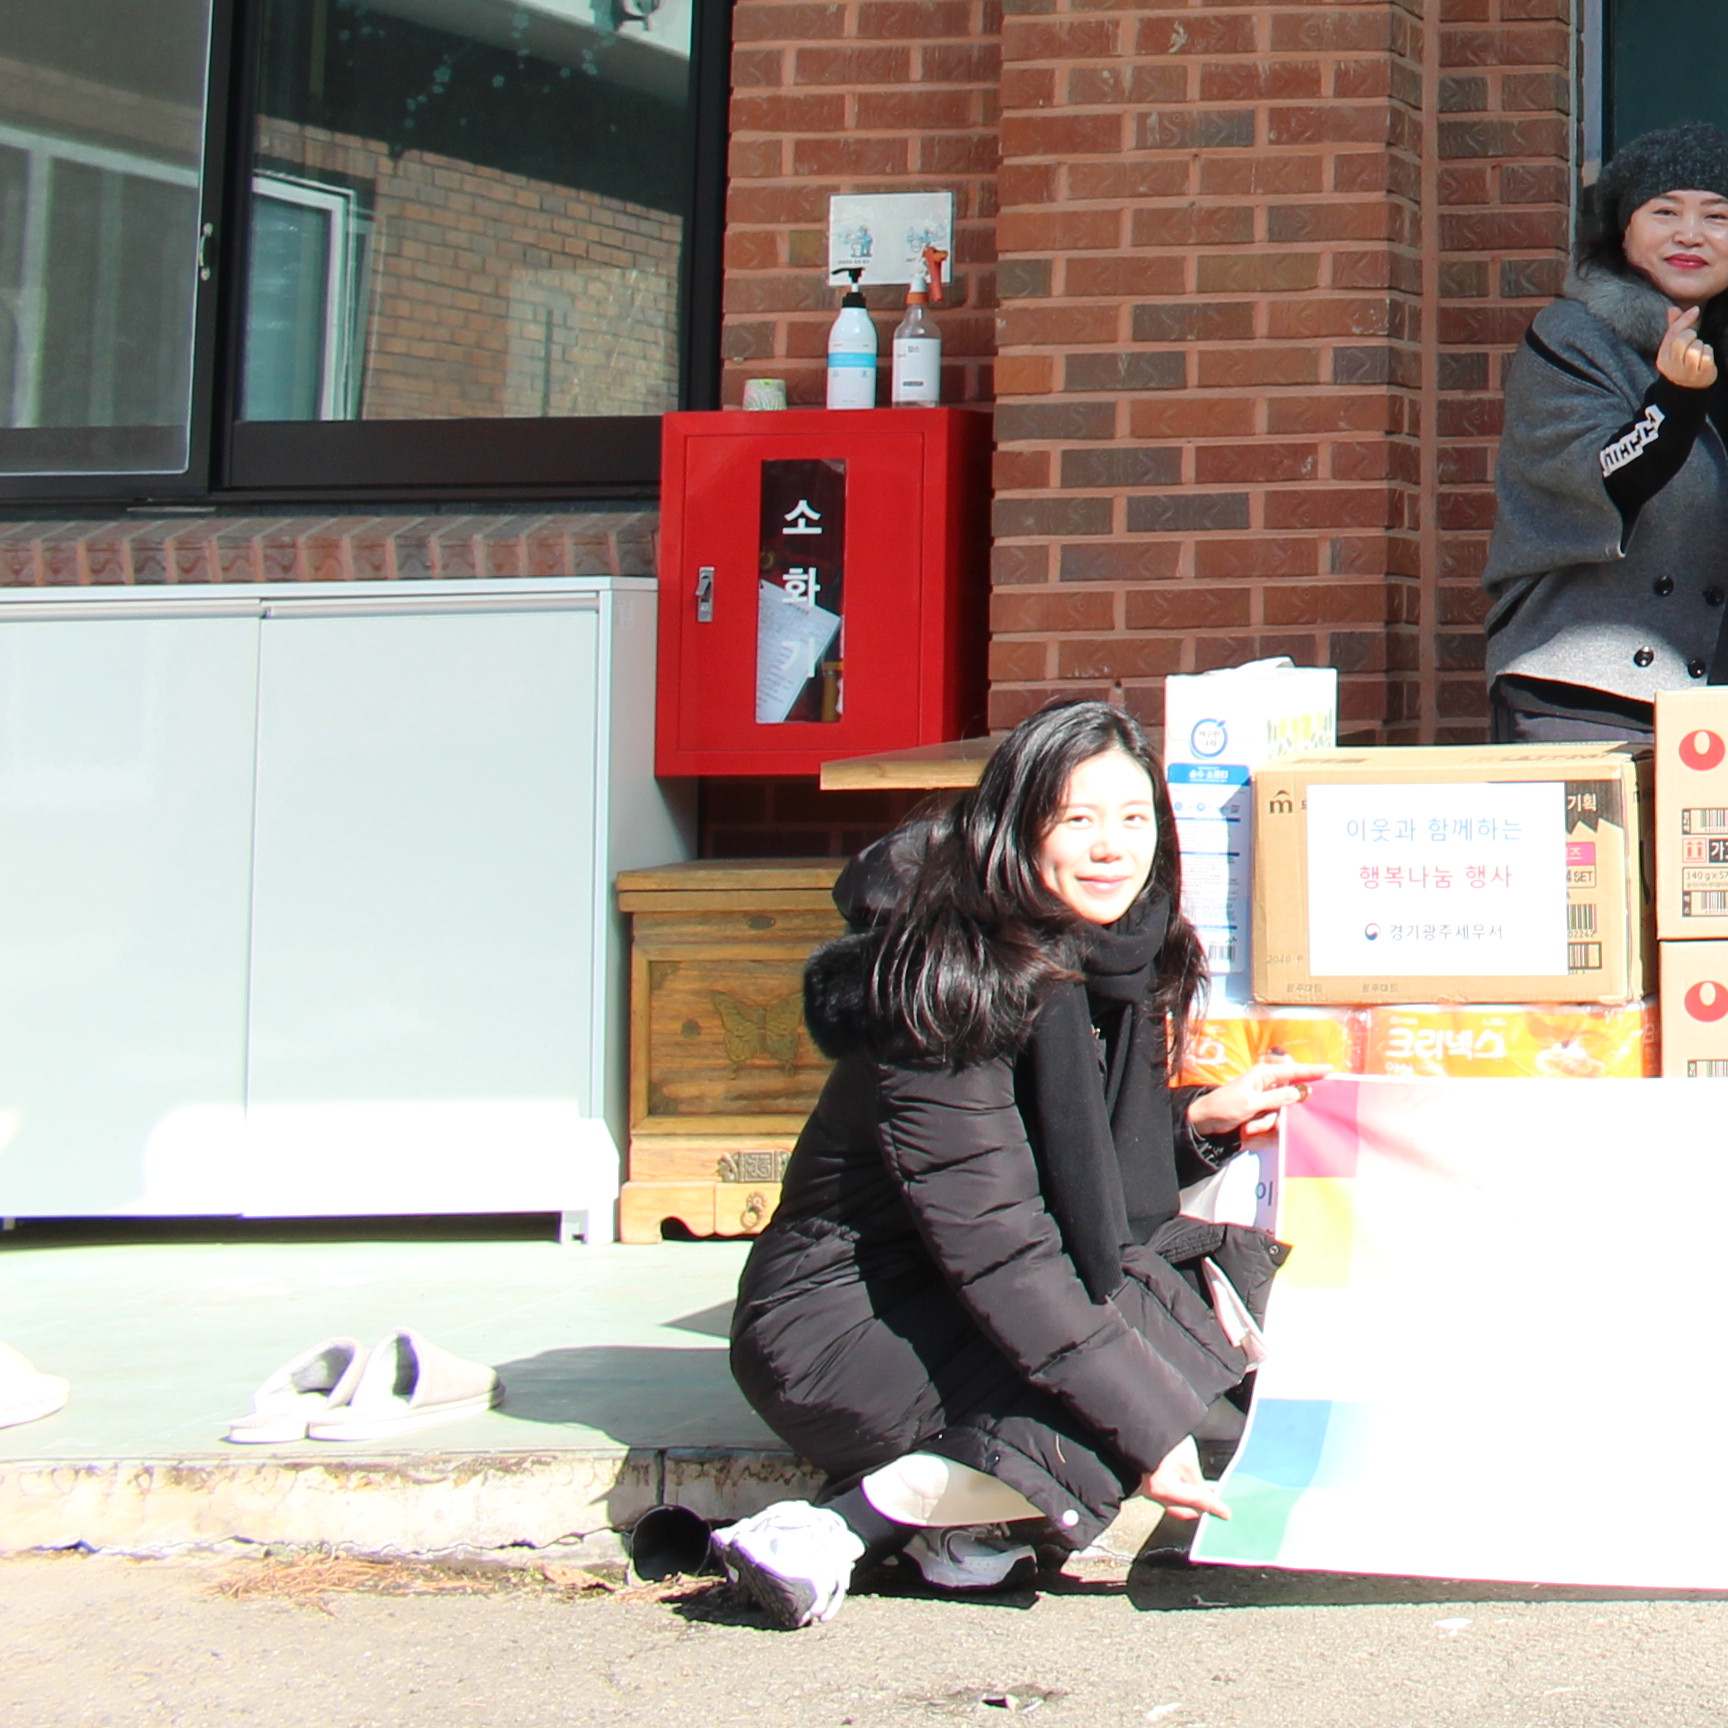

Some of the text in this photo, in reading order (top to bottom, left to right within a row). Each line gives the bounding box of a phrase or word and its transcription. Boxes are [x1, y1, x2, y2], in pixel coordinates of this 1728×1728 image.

[1347, 818, 1522, 842] 이웃과 함께하는
[1360, 865, 1512, 889] 행복나눔 행사
[1389, 924, 1502, 941] 경기광주세무서
[1385, 1027, 1507, 1060] 크리넥스
